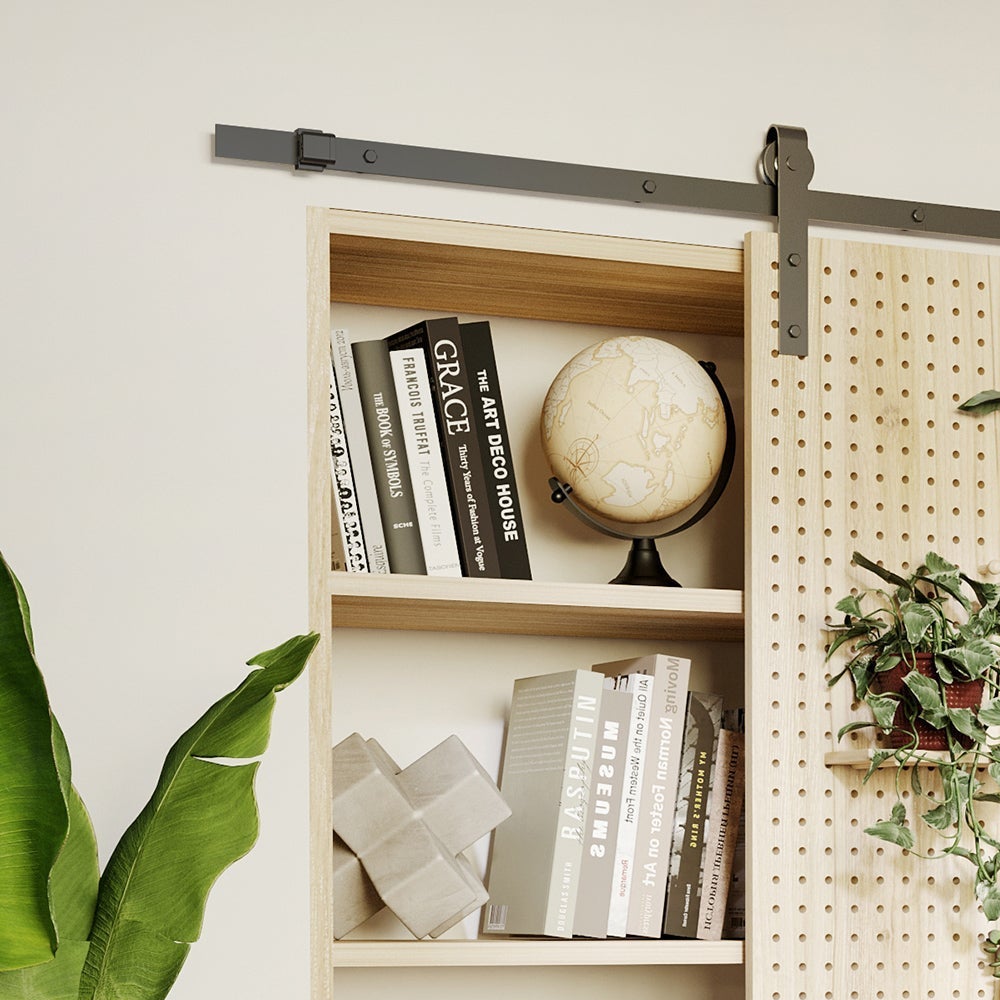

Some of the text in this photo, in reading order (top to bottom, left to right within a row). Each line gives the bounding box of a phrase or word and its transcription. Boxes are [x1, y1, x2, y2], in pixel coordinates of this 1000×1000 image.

[372, 392, 382, 408] THE
[376, 408, 393, 438] BOOK
[402, 356, 421, 408] FRANCOIS
[412, 412, 430, 456] TRUFFAT
[433, 339, 470, 436] GRACE
[384, 452, 404, 498] SYMBOLS
[477, 369, 519, 542] THE ART DECO HOUSE
[420, 460, 442, 548] The Complete Films
[458, 444, 486, 571] Thirty Years of Fashion at Vogue
[561, 696, 597, 841] RASPUTIN
[556, 862, 572, 932] DOUGLAS SMITH
